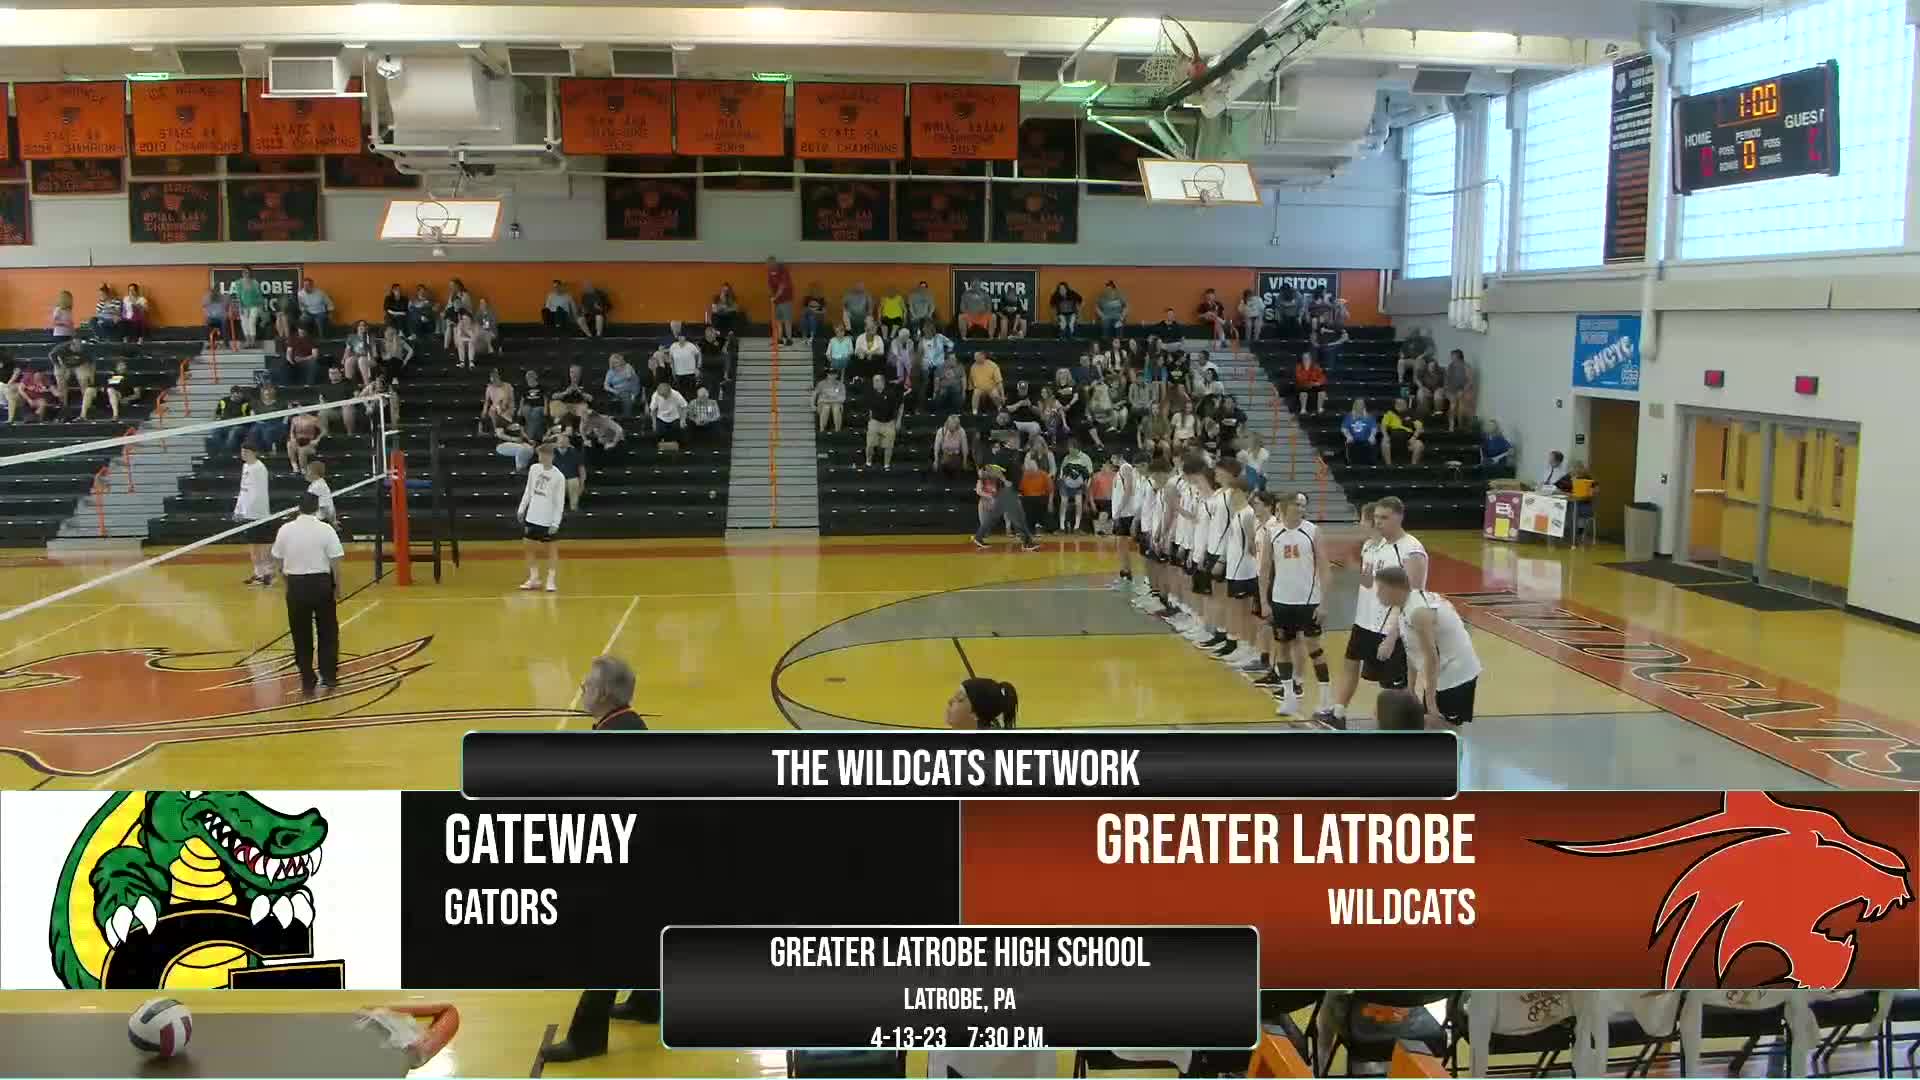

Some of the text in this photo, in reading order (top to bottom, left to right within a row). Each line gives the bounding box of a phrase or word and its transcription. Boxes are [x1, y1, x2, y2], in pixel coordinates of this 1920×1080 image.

[1738, 83, 1777, 118] 1:00
[1784, 108, 1825, 129] GUEST
[1684, 130, 1713, 149] HOME
[1743, 139, 1756, 171] 0
[963, 281, 1027, 297] VSITOR
[1268, 276, 1328, 291] VISITOR
